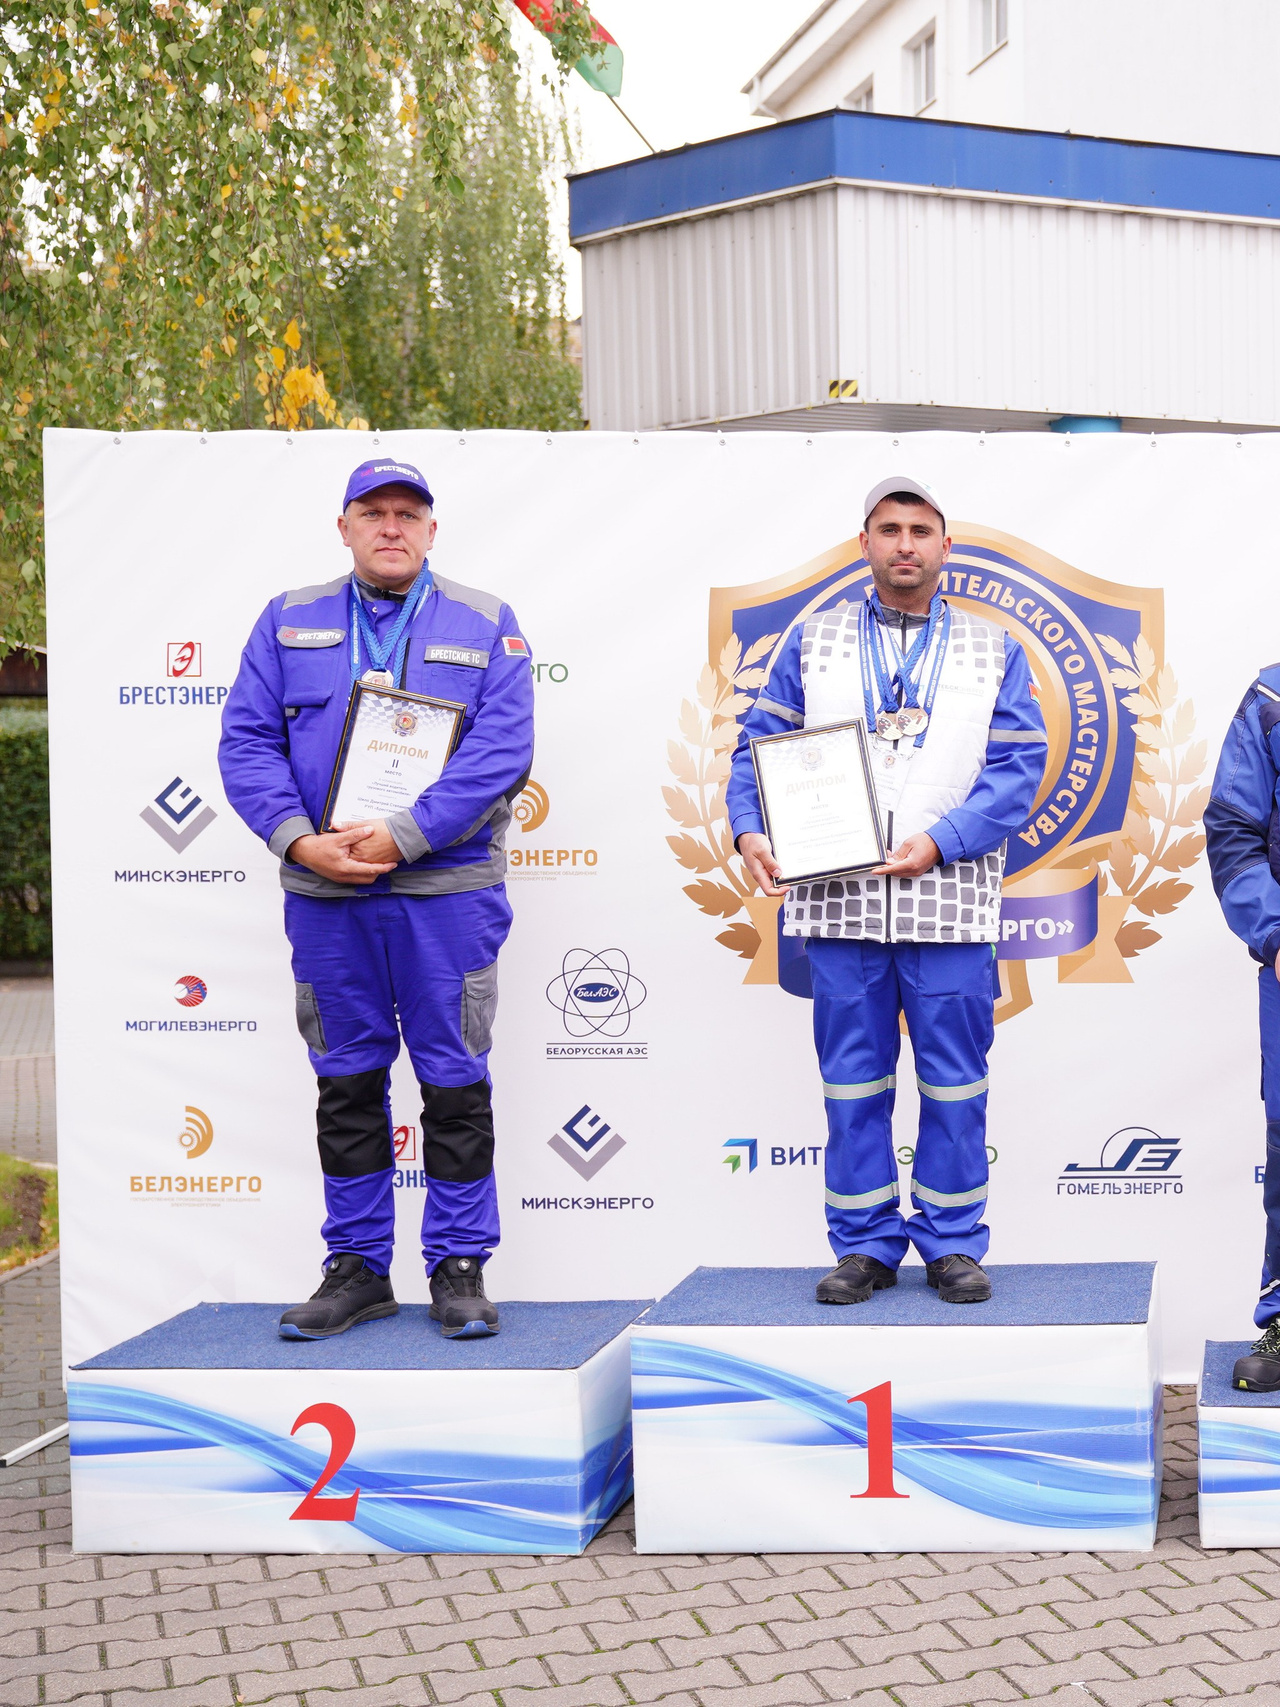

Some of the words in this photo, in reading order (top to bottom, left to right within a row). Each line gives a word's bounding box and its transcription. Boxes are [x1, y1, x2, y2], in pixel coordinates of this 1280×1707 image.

[430, 648, 470, 662] БРЕСТСКИЕ
[471, 654, 481, 664] ТС
[119, 686, 233, 706] БРЕСТЭНЕР
[937, 570, 1086, 675] ИТЕЛЬСКОГО
[1017, 680, 1100, 848] МАСТЕРСТВА
[367, 739, 429, 760] ДИПЛОМ
[785, 773, 847, 798] ДИПЛОМ
[504, 849, 598, 867] ЭНЕРГО
[114, 869, 247, 883] МИНСКЭНЕРГО
[576, 986, 618, 998] БелАЭС
[125, 1020, 258, 1032] МОГИЛЕВЭНЕРГО
[546, 1047, 624, 1056] БЕЛОРУССКАЯ
[626, 1047, 648, 1056] АЭС
[130, 1175, 262, 1193] БЕЛЭНЕРГО
[1056, 1181, 1184, 1196] ГОМЕЛЬЭНЕРГО
[521, 1196, 655, 1210] МИНСКЭНЕРГО
[847, 1380, 910, 1499] 1
[288, 1402, 361, 1522] 2
